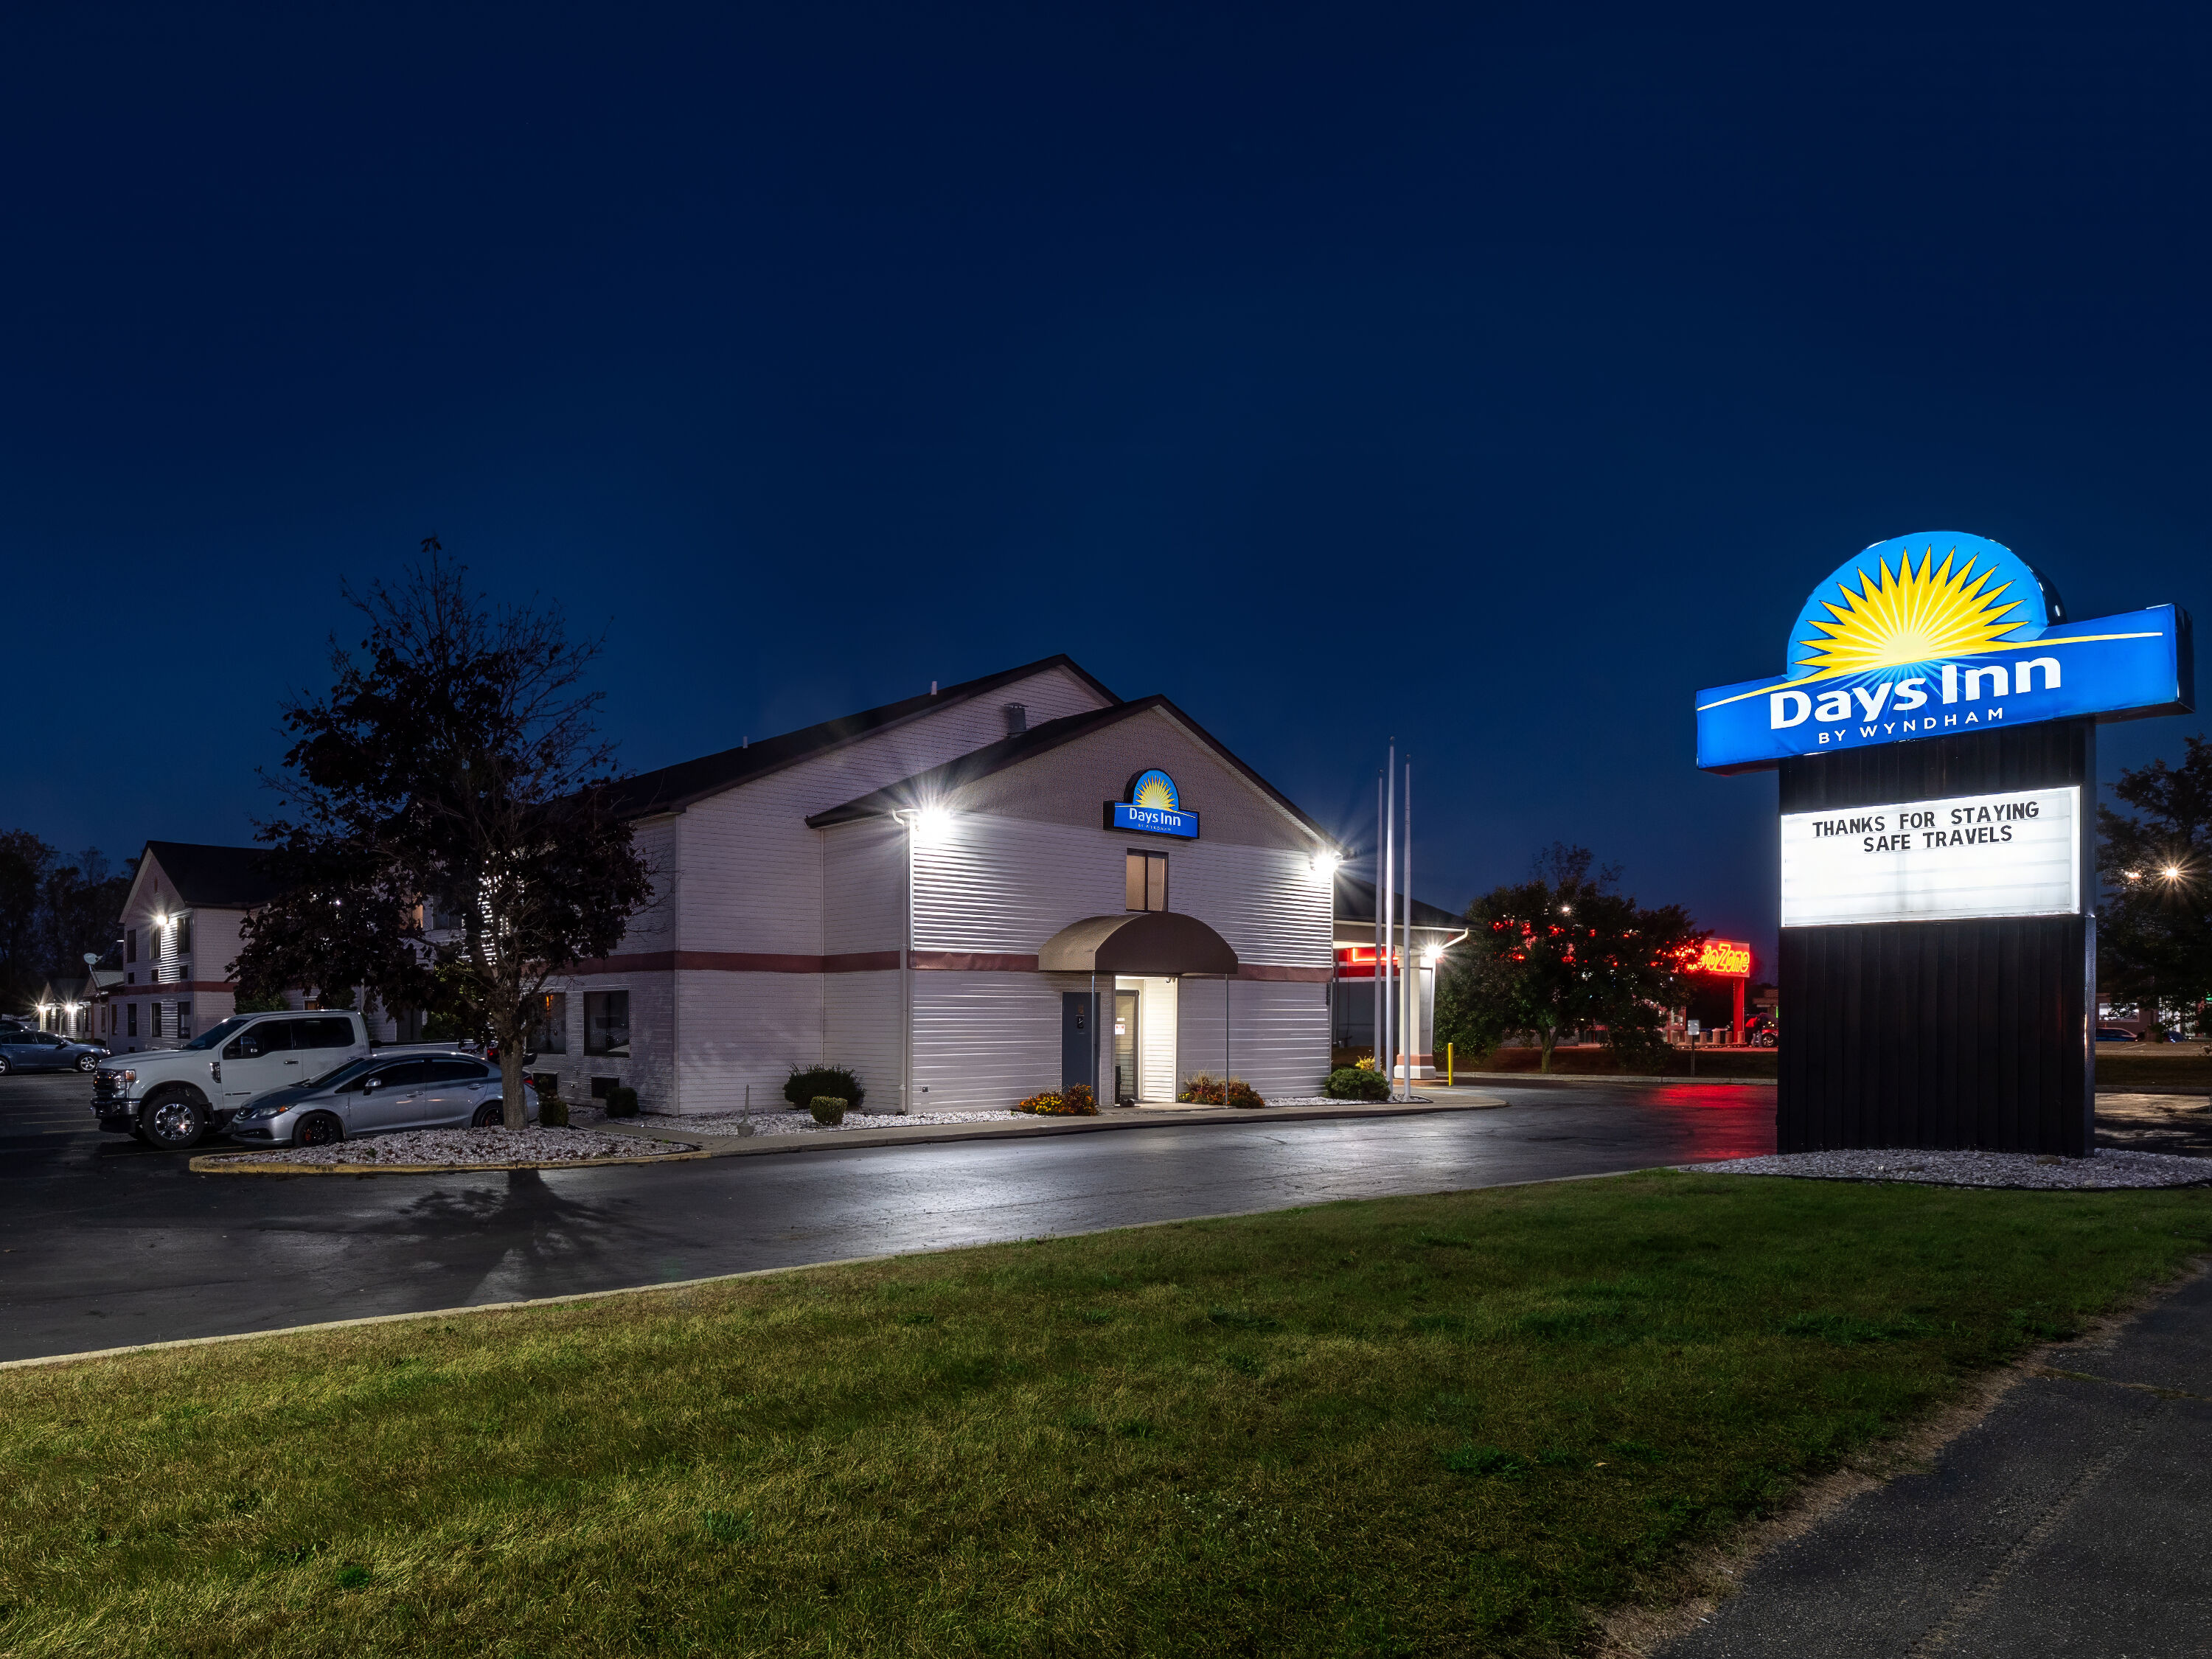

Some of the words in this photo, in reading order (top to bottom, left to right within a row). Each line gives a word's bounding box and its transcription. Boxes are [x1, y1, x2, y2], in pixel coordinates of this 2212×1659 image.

[1770, 678, 1928, 729] Days
[1942, 656, 2062, 705] Inn
[1818, 729, 1847, 745] BY
[1859, 707, 2003, 738] WYNDHAM
[1129, 807, 1159, 824] Days
[1161, 812, 1181, 827] Inn
[1812, 815, 1885, 838] THANKS
[1899, 811, 1935, 830] FOR
[1950, 801, 2039, 825] STAYING
[1863, 834, 1911, 852] SAFE
[1922, 825, 2013, 848] TRAVELS
